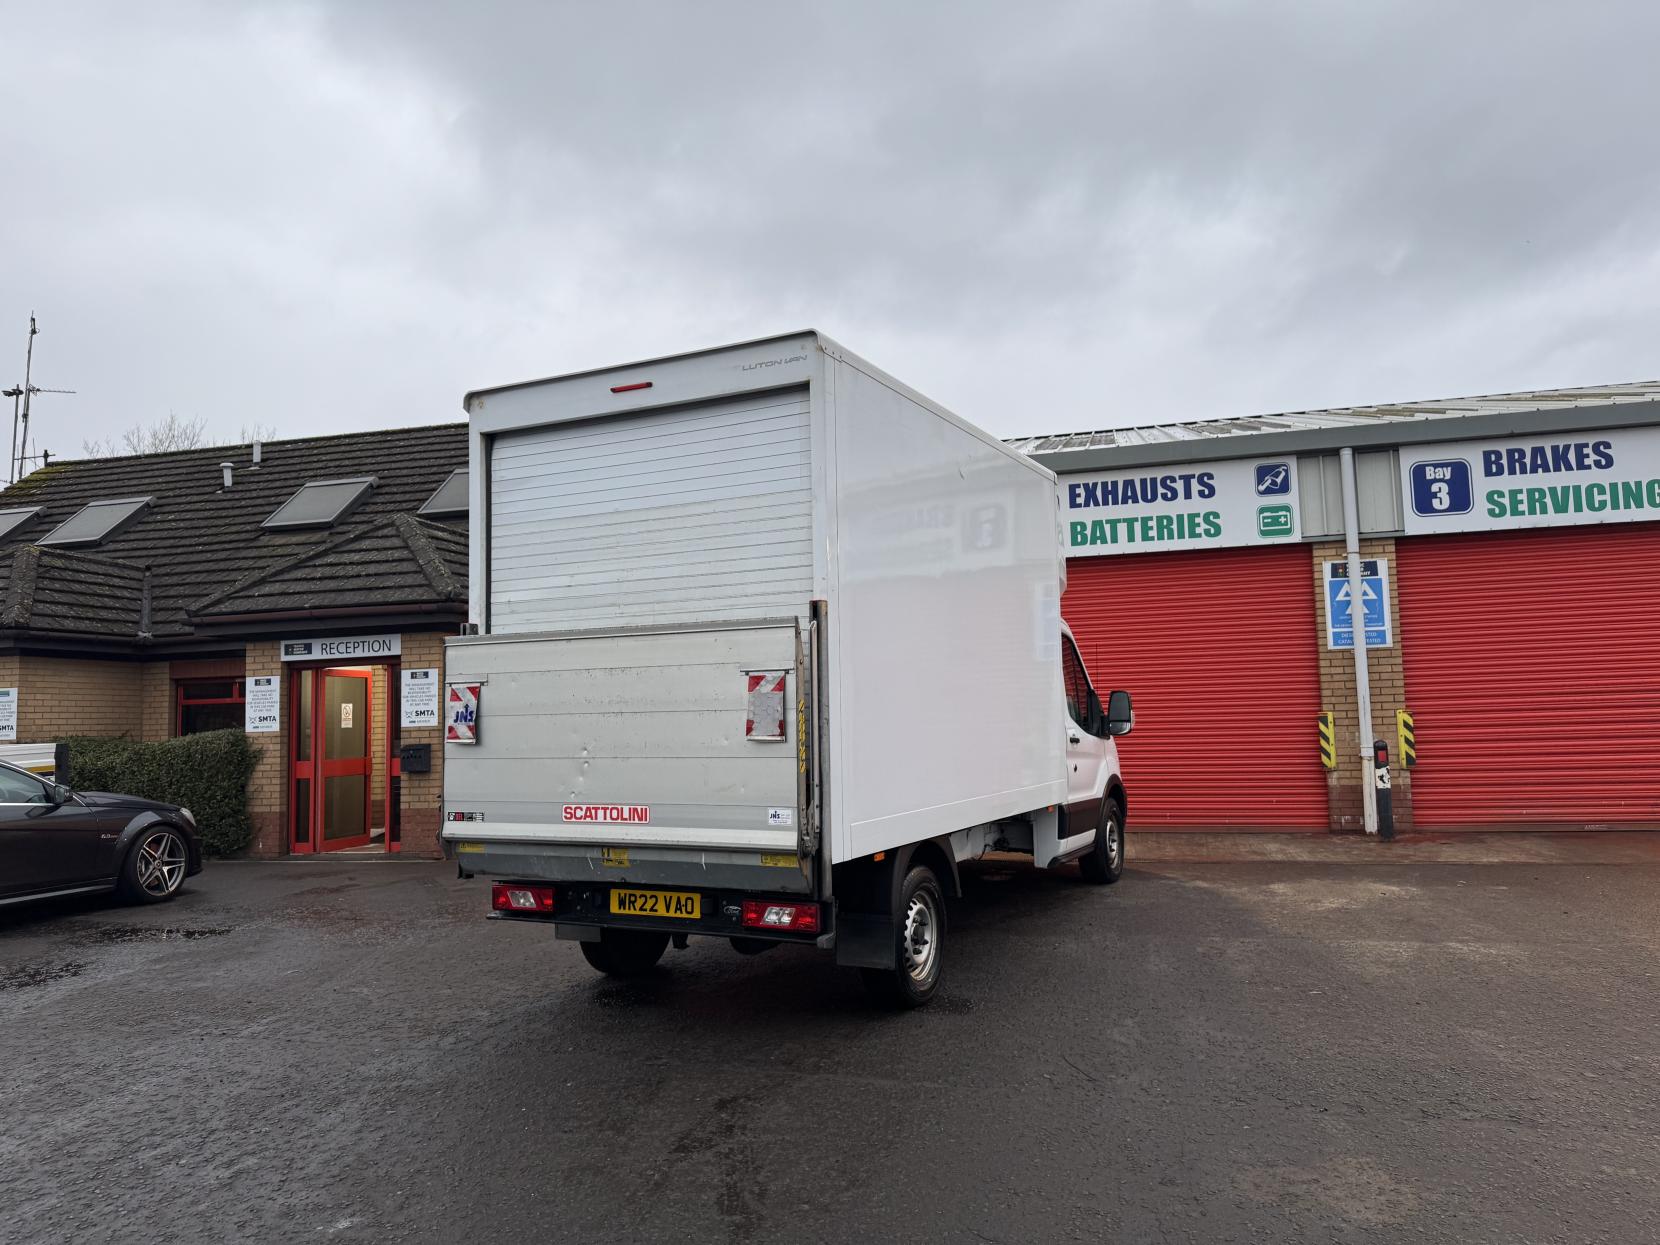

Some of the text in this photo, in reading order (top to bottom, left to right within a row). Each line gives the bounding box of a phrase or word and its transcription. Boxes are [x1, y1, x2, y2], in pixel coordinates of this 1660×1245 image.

[742, 359, 782, 371] LUTON
[1482, 440, 1614, 478] BRAKES
[1425, 466, 1452, 481] Bay
[1068, 472, 1219, 508] EXHAUSTS
[1431, 482, 1451, 511] 3
[1070, 511, 1222, 547] BATTERIES
[320, 639, 392, 655] RECEPTION
[258, 715, 277, 723] SMTA
[453, 706, 475, 723] JNS
[563, 806, 649, 822] SCATTOLINI
[618, 892, 695, 915] WR22 VAO
